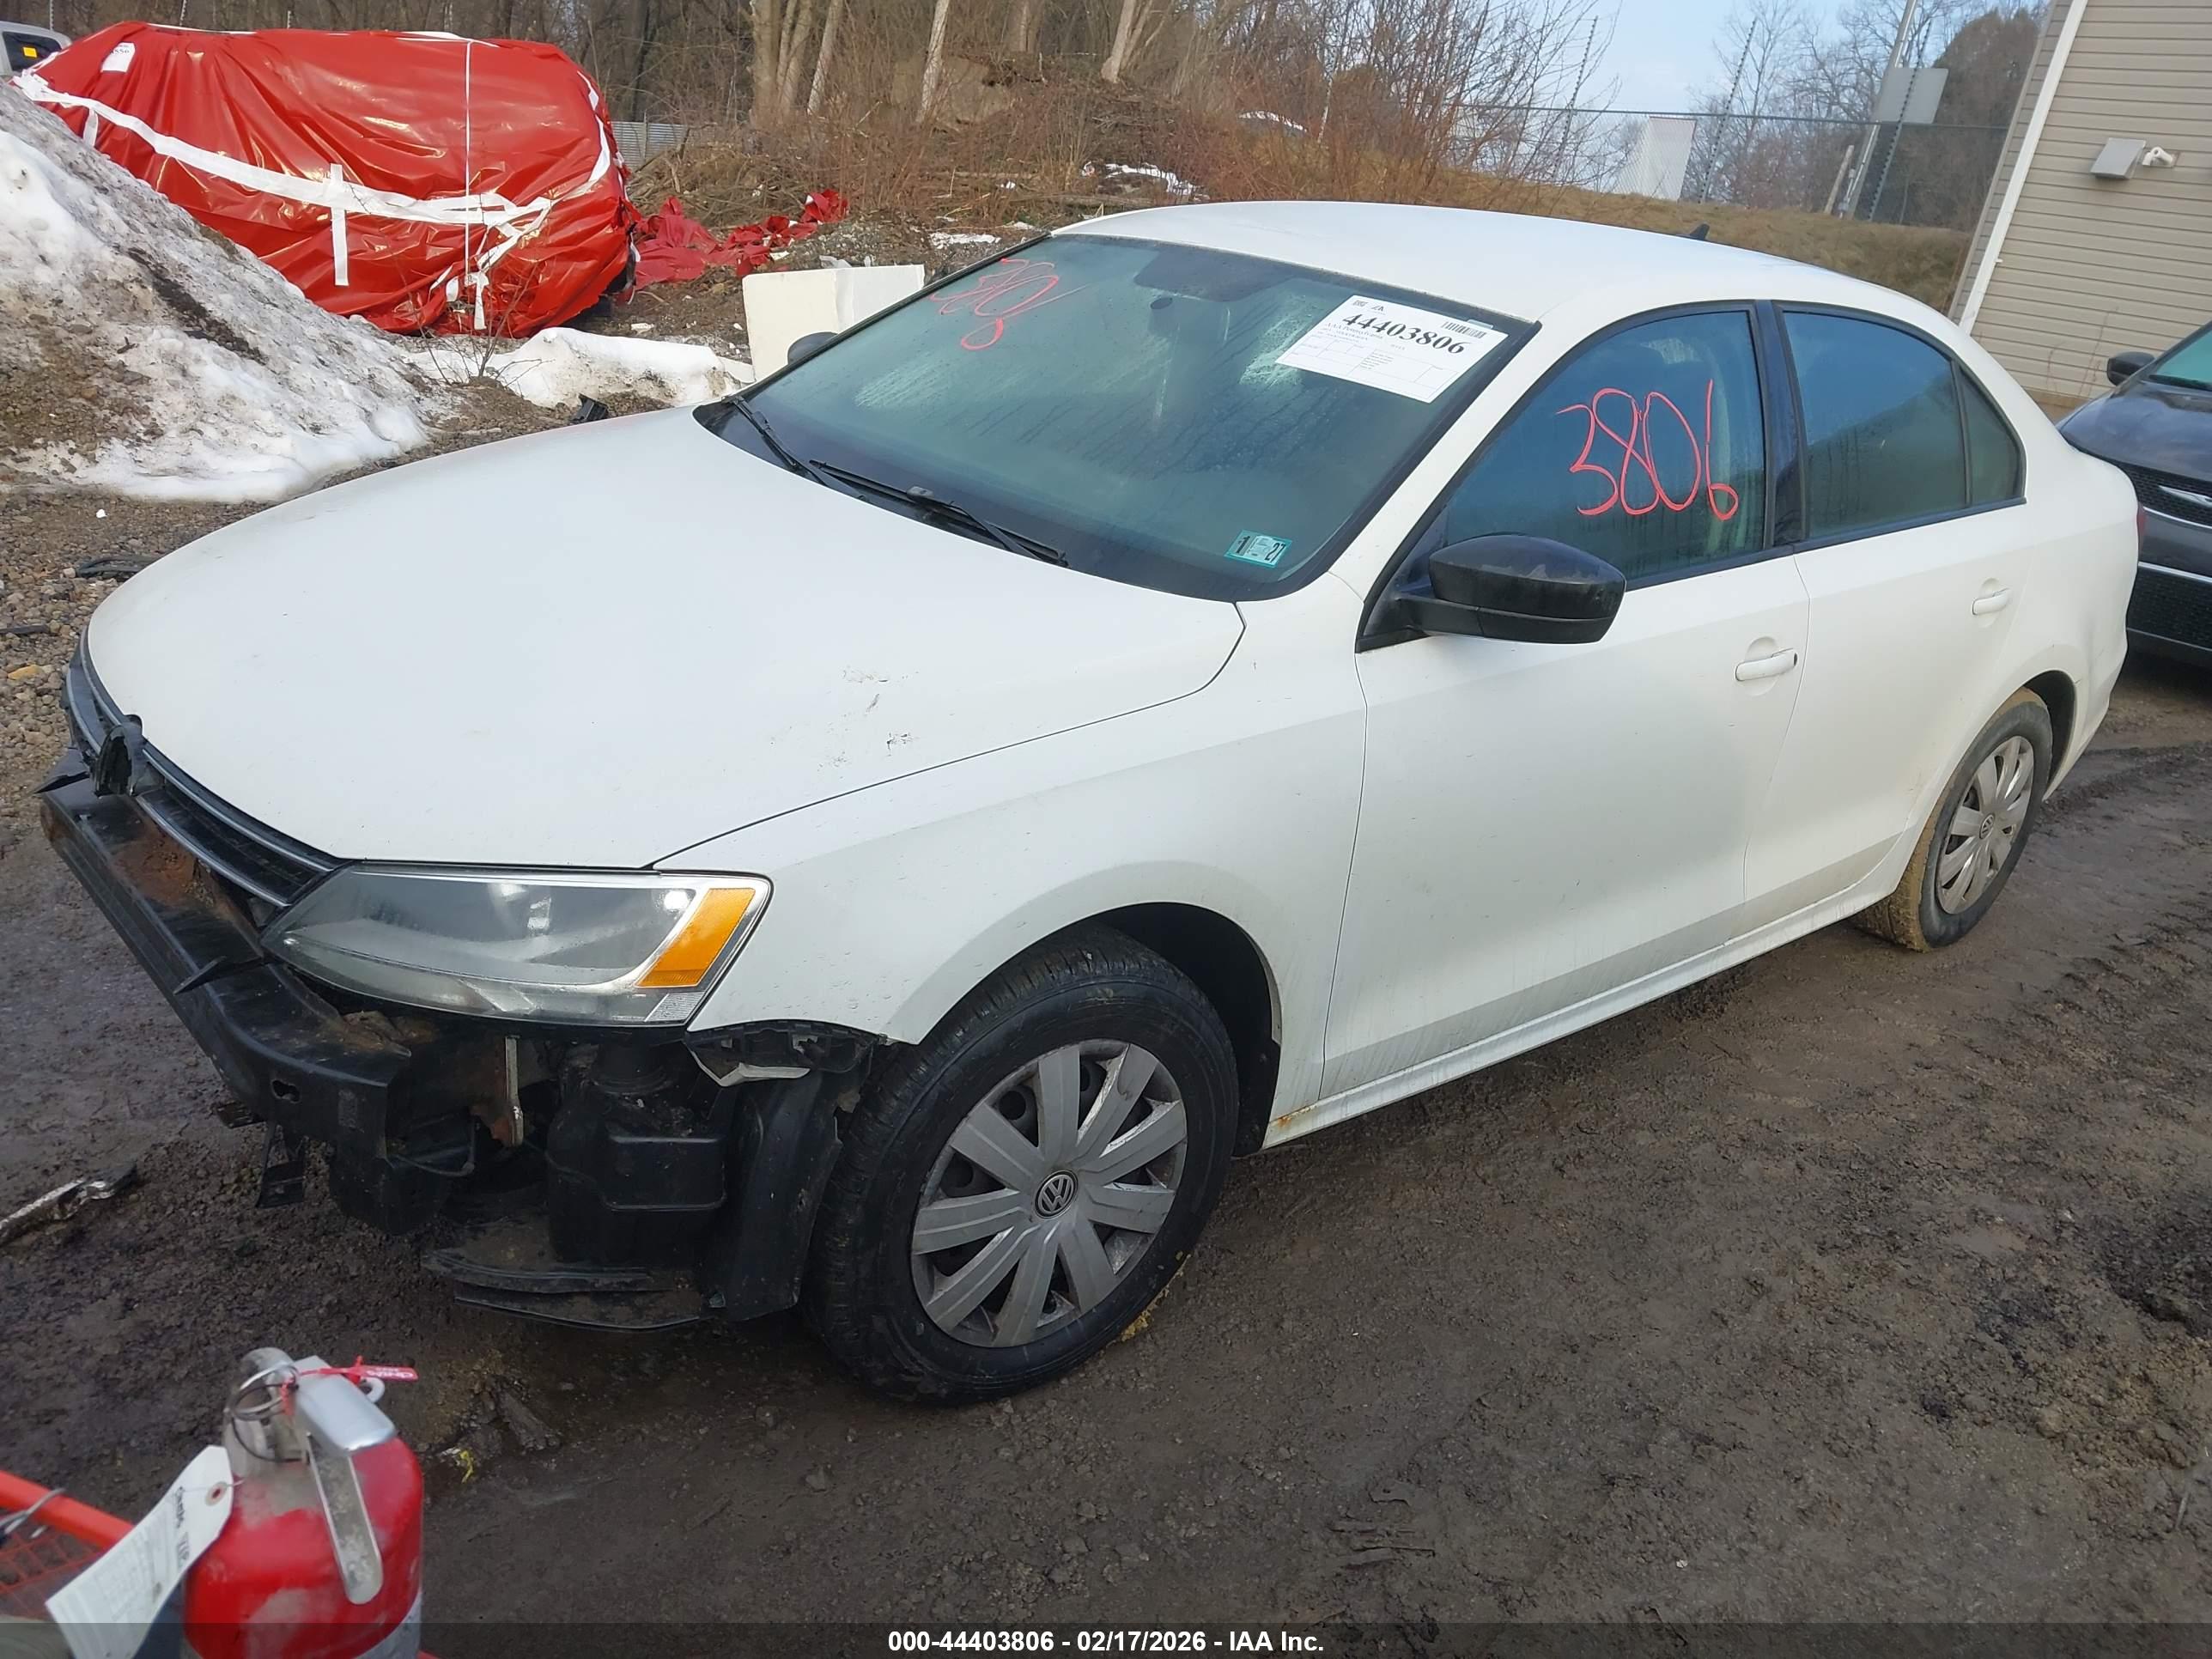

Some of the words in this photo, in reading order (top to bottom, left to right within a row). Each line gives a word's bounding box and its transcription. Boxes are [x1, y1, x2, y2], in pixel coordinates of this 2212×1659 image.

[1342, 313, 1470, 354] 44403806
[1556, 379, 1739, 520] 3806
[1037, 1174, 1074, 1213] VW
